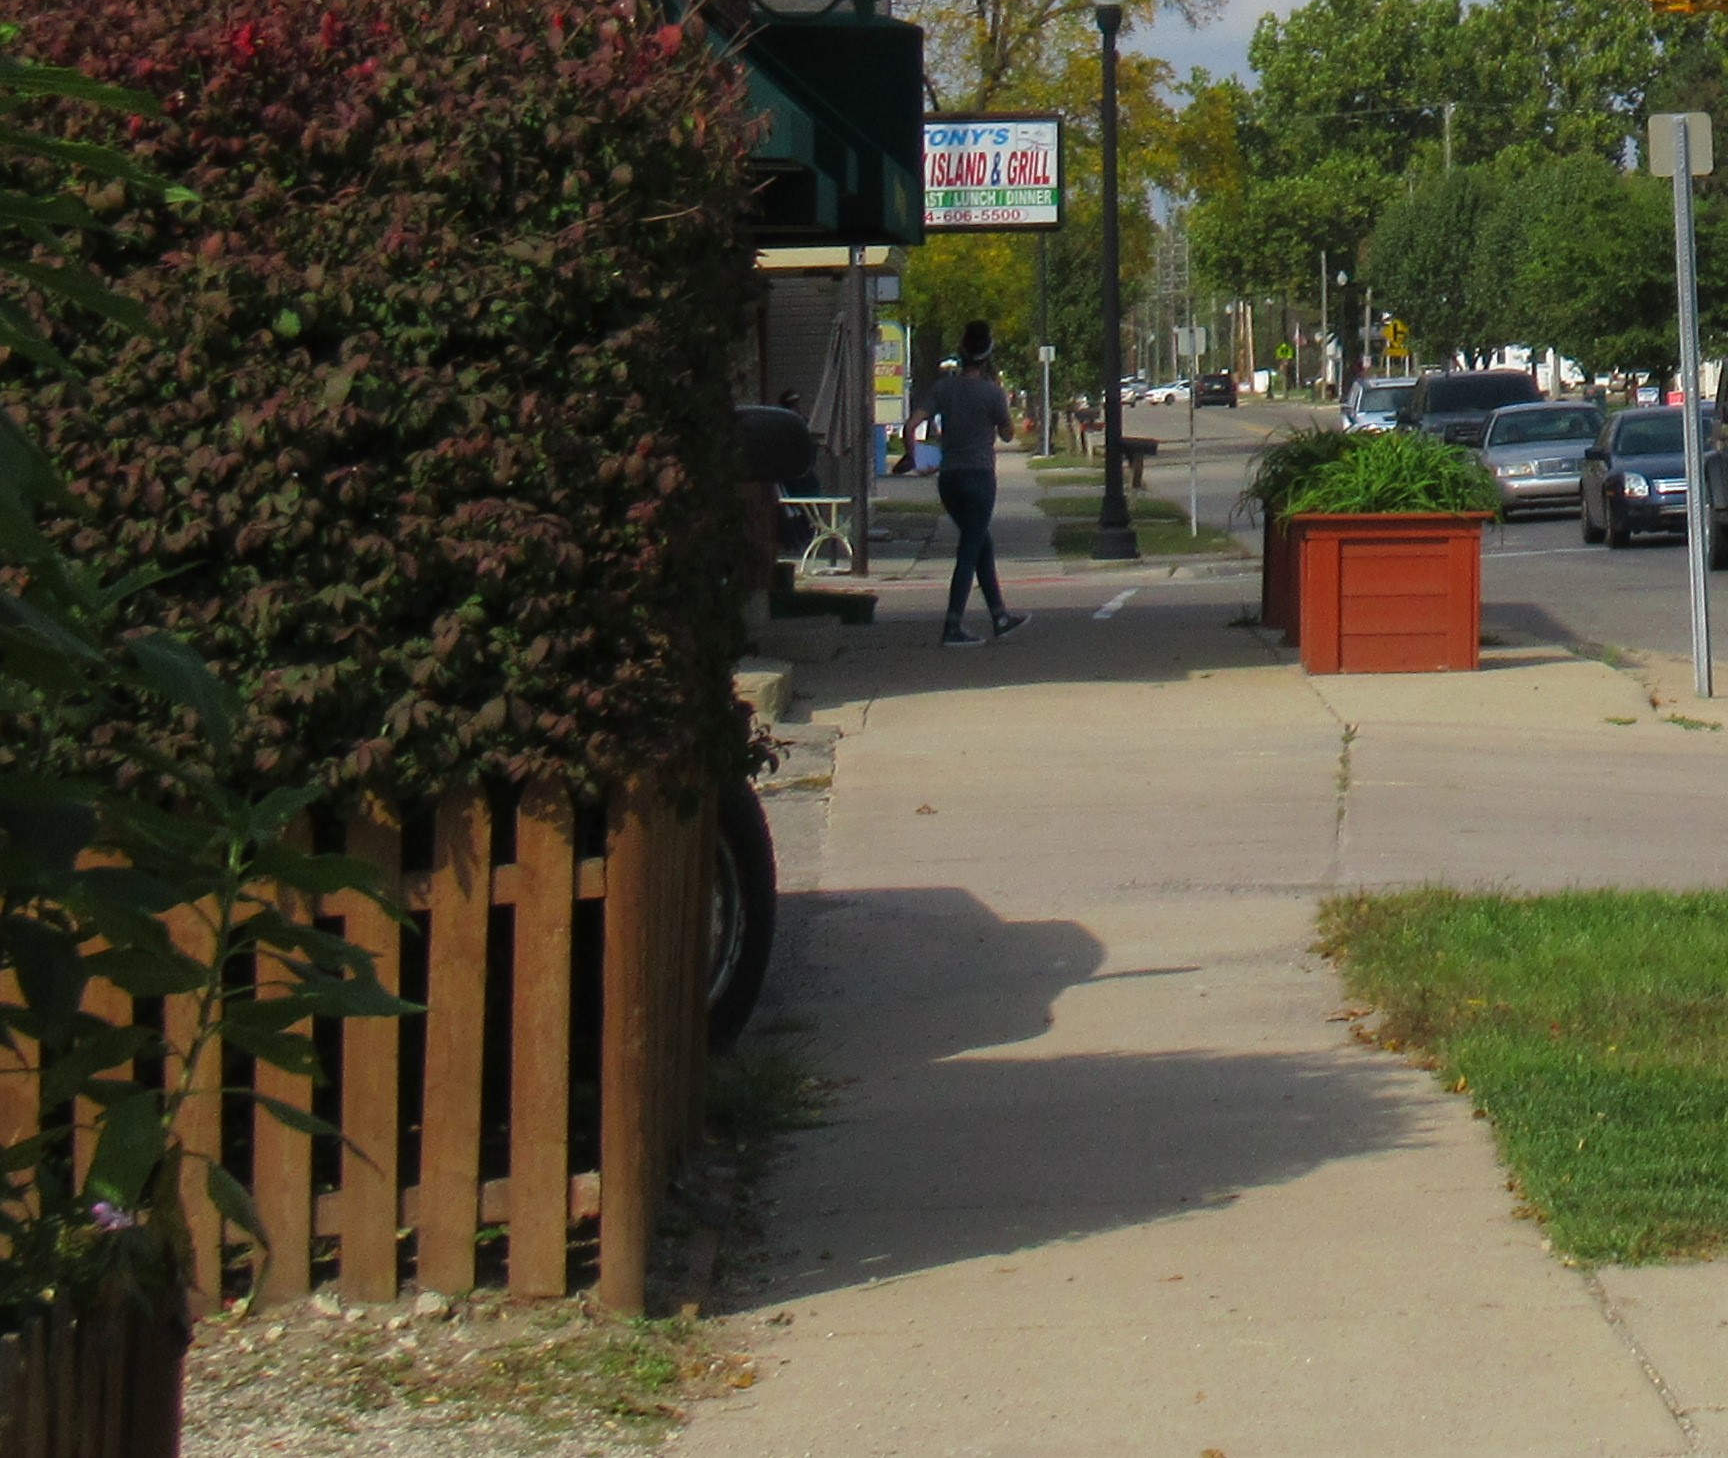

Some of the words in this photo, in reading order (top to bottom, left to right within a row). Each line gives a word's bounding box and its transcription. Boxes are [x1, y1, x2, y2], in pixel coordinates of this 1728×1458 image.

[924, 128, 1010, 147] ONY'S
[930, 152, 987, 187] ISLAND
[991, 151, 1001, 186] &
[1007, 151, 1051, 185] GRILL
[953, 192, 996, 206] LUNCH
[1007, 190, 1052, 205] DINNER
